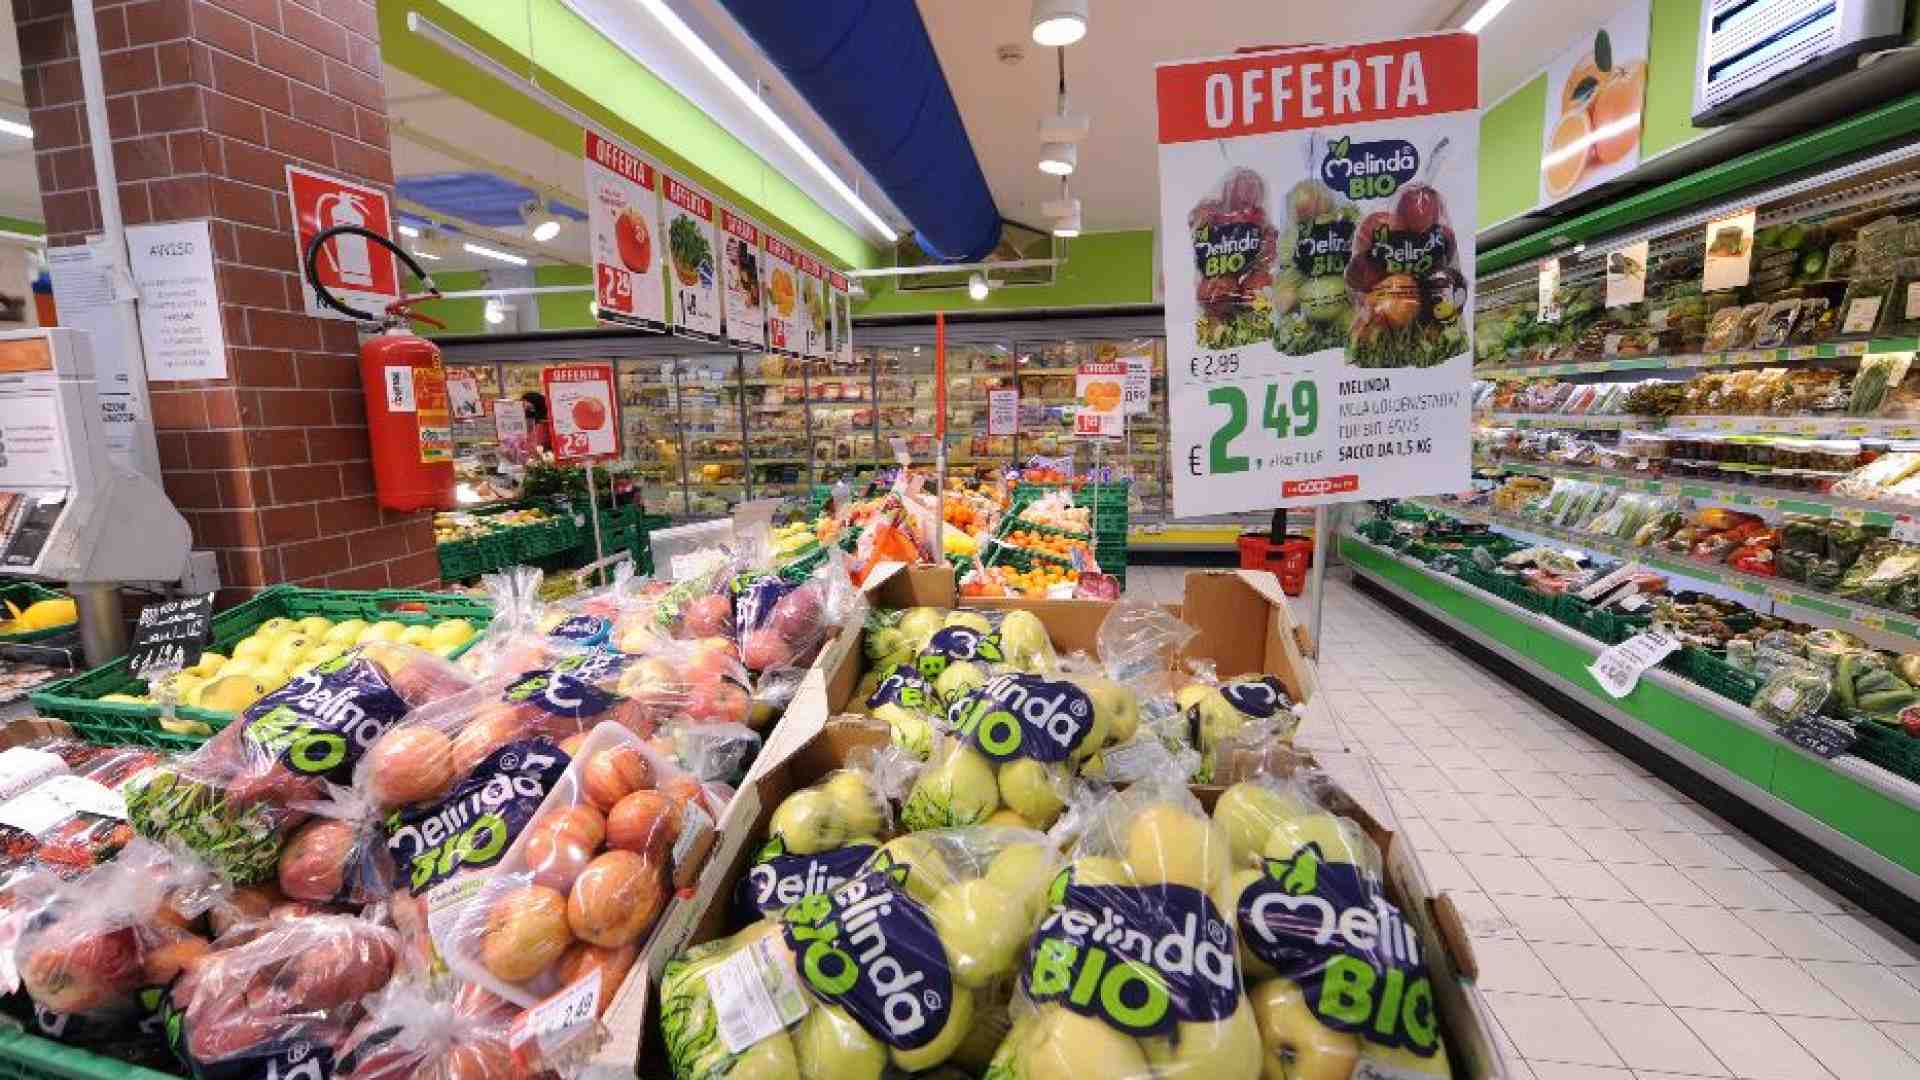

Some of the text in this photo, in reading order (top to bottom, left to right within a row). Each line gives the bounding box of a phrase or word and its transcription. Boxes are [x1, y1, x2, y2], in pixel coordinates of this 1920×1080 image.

[1205, 50, 1429, 129] OFFERTA
[597, 139, 646, 184] OFFERTA
[1327, 149, 1415, 177] Melinda
[1350, 174, 1397, 198] BIO
[1206, 254, 1246, 276] BIO
[553, 369, 600, 380] OFFERTA
[1204, 353, 1240, 376] 2,99
[1339, 377, 1391, 396] MELINDA
[1188, 445, 1202, 476] €
[1339, 443, 1374, 461] SACCO
[1378, 441, 1394, 458] DA
[1417, 438, 1432, 454] KG
[750, 859, 849, 905] elin
[1251, 891, 1419, 967] Meli
[833, 879, 926, 1035] elinda
[1031, 937, 1170, 1028] BIO
[1318, 954, 1437, 1046] BIO
